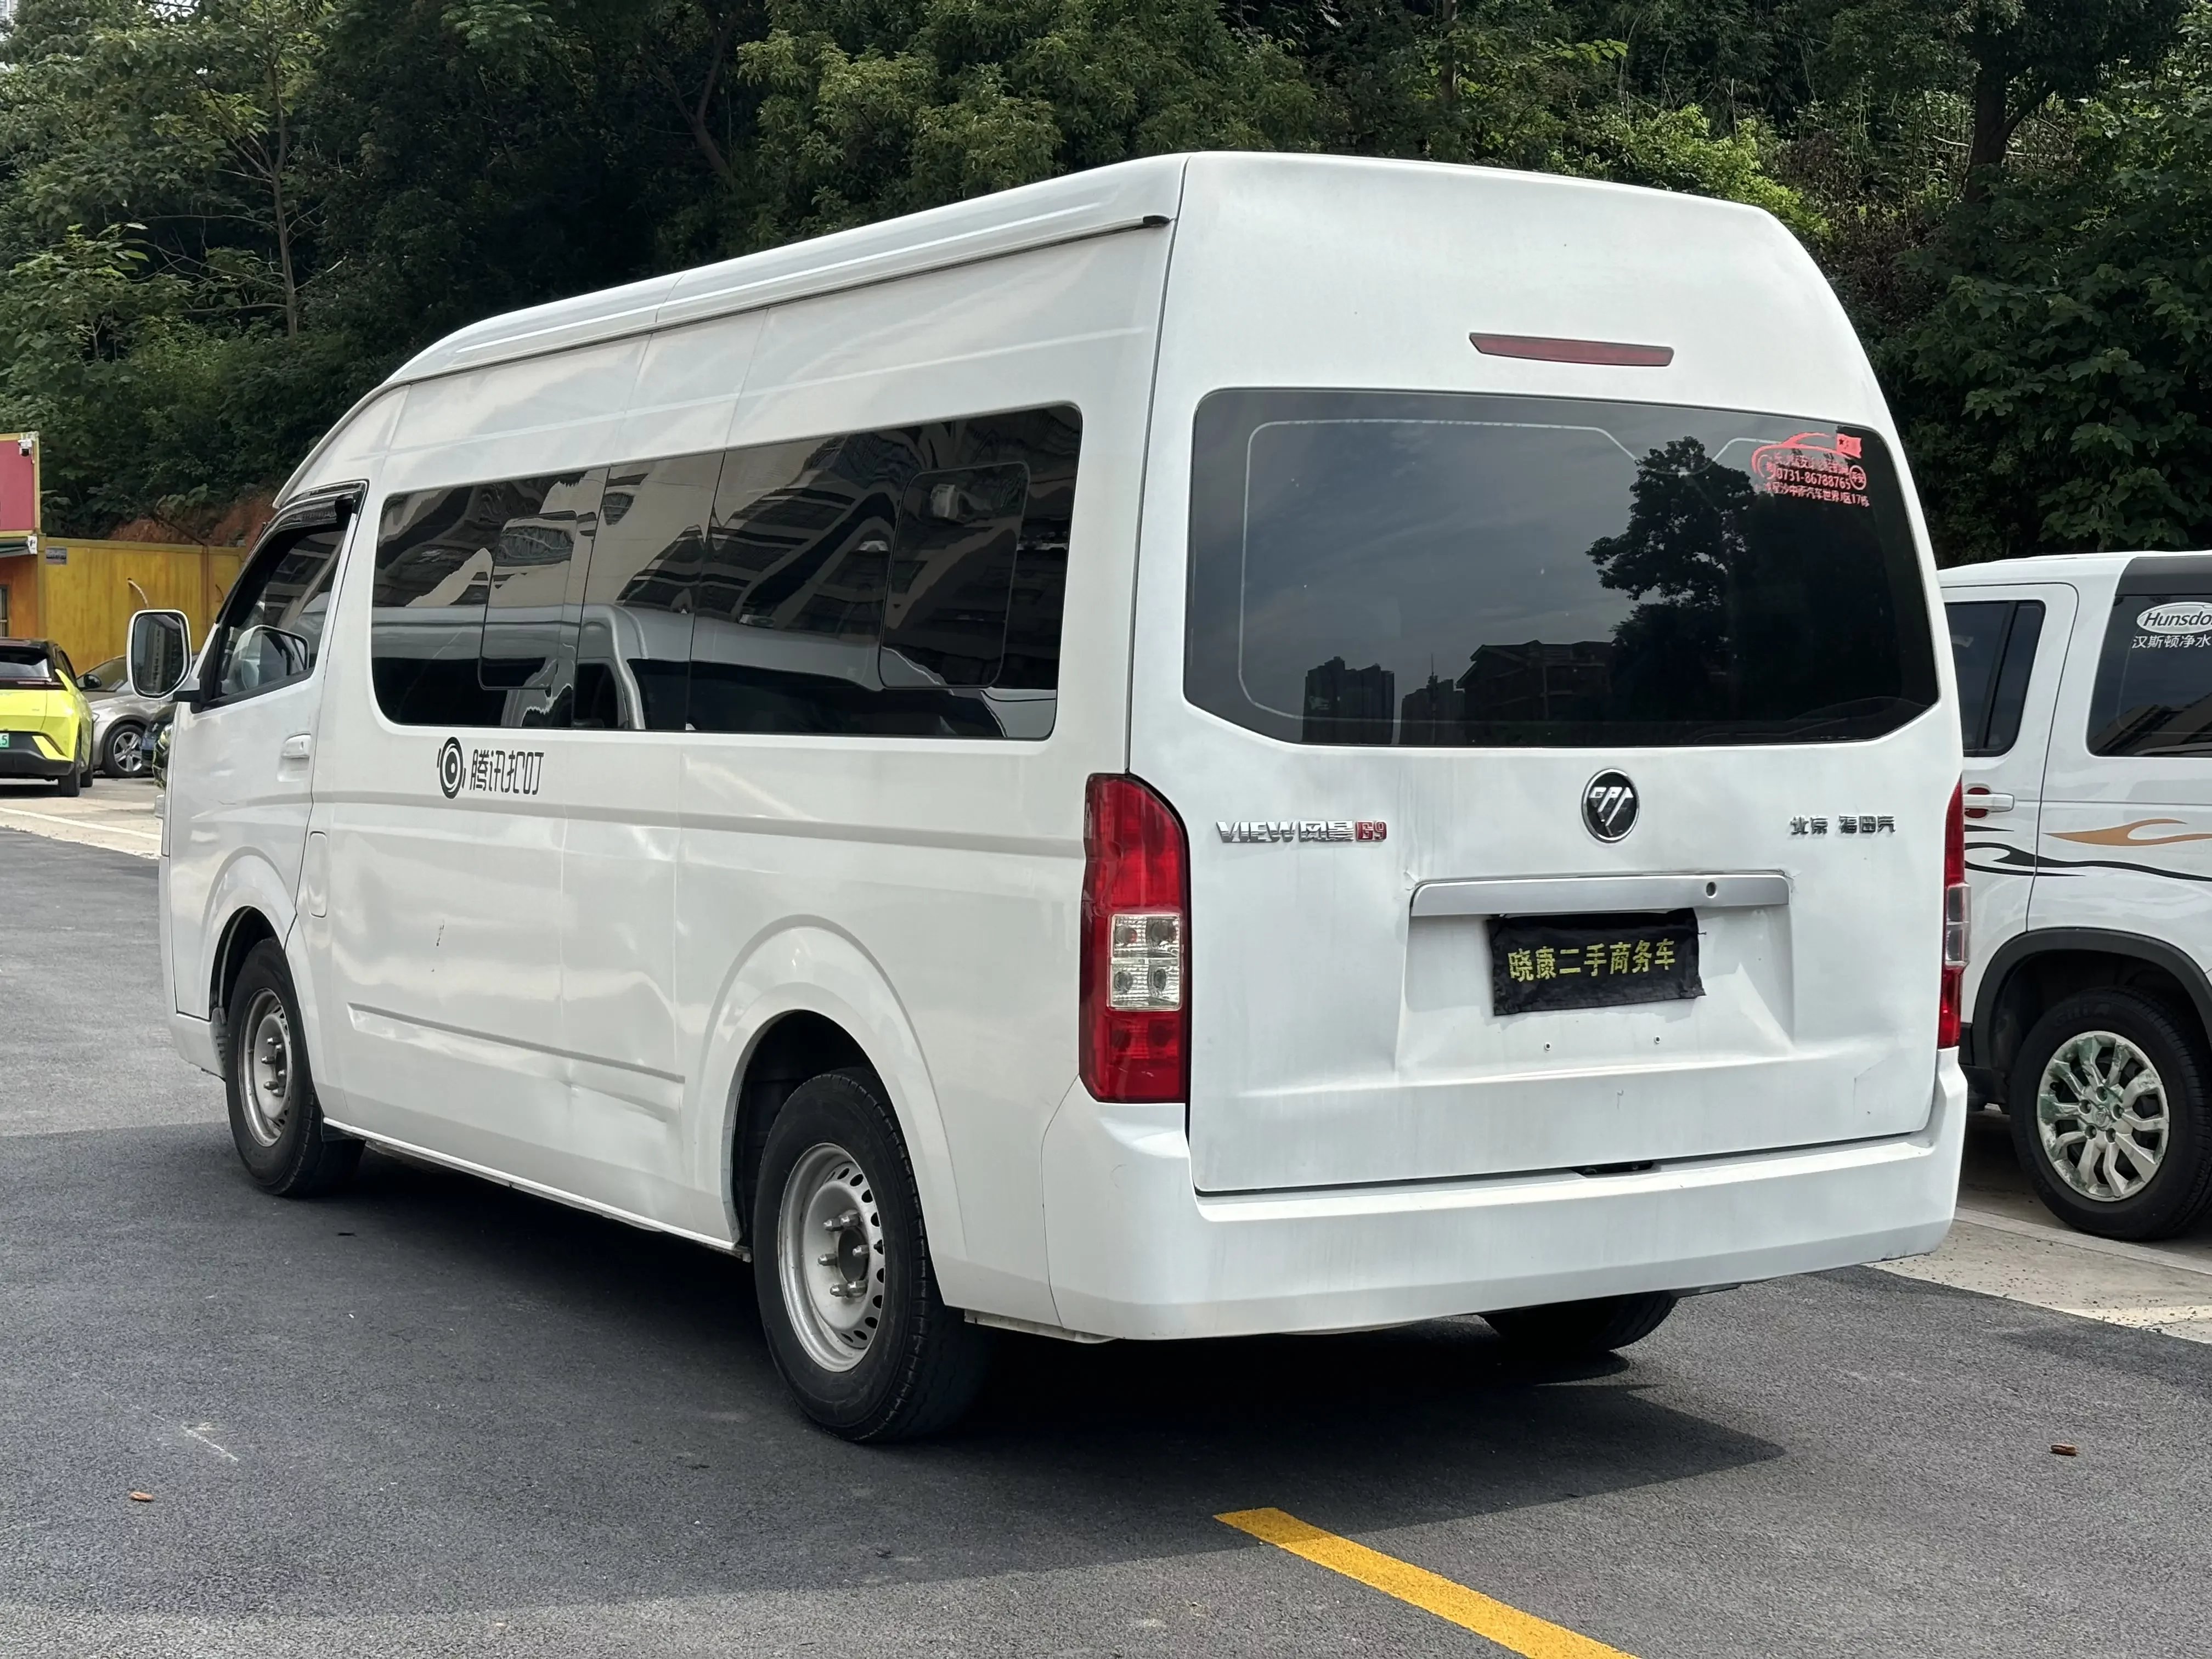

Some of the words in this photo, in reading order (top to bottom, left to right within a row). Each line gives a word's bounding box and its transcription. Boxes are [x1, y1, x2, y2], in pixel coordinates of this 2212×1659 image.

[2143, 611, 2212, 627] Hunsdo
[2131, 634, 2212, 648] 汉斯顿净水
[1216, 820, 1297, 843] VIEW
[1507, 938, 1675, 982] 晓康二手商务车
